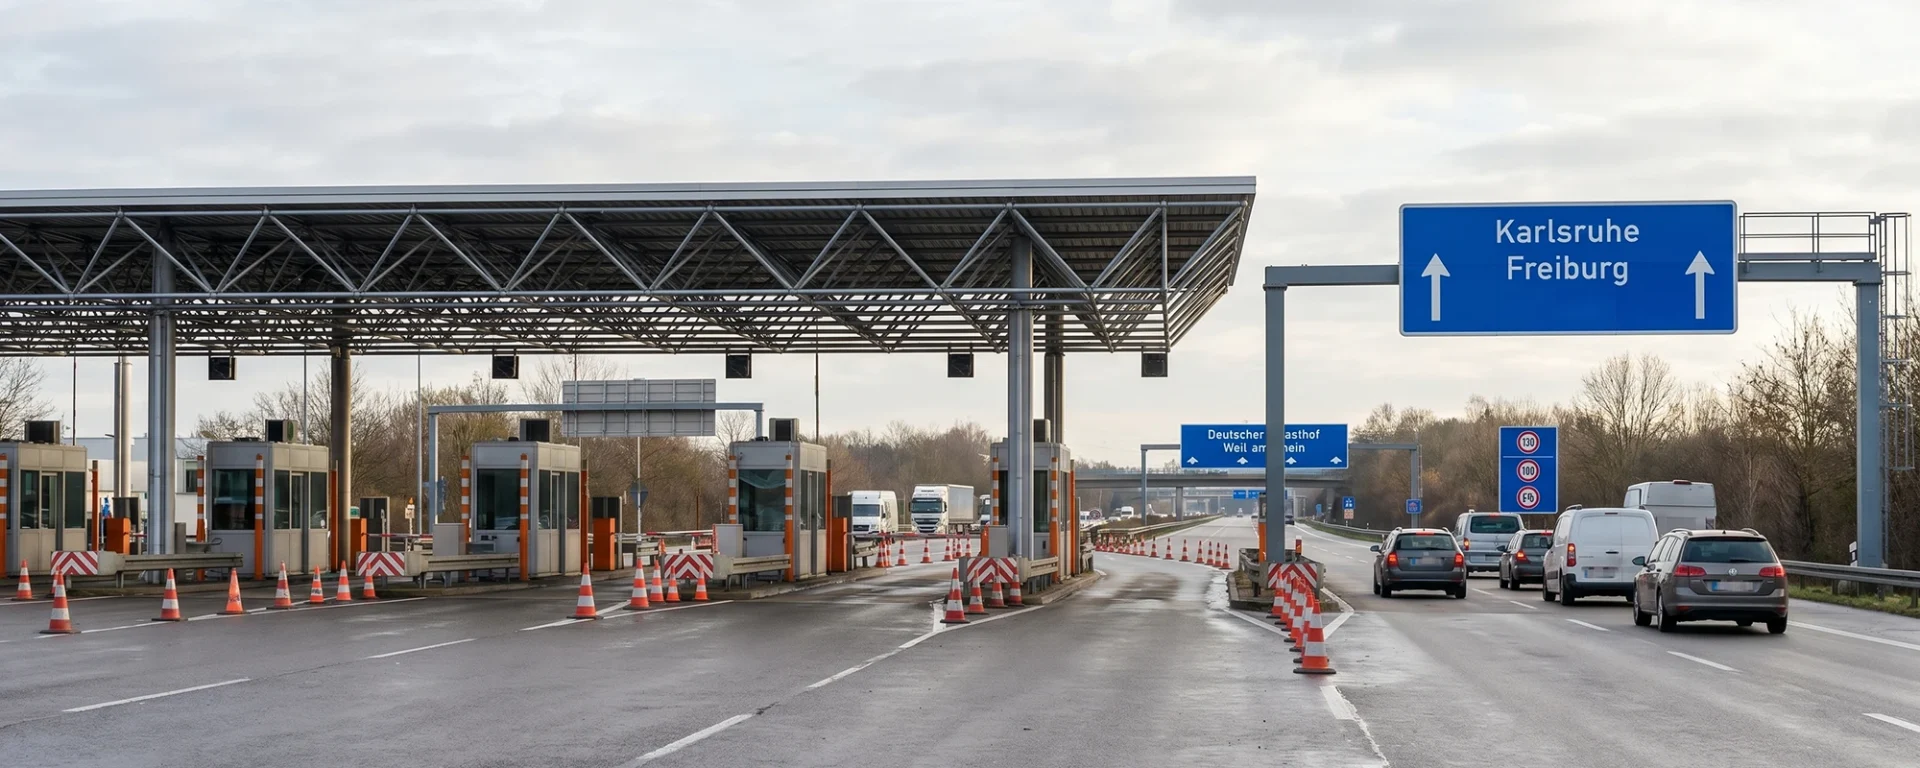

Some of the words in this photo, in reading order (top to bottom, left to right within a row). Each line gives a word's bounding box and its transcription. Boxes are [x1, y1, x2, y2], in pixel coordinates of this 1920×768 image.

[1495, 218, 1640, 244] Karlsruhe
[1507, 255, 1629, 286] Freiburg
[1207, 429, 1265, 440] Deutscher
[1284, 429, 1320, 440] asthof
[1223, 442, 1247, 453] Weil
[1522, 437, 1535, 447] 130
[1522, 466, 1535, 476] 100
